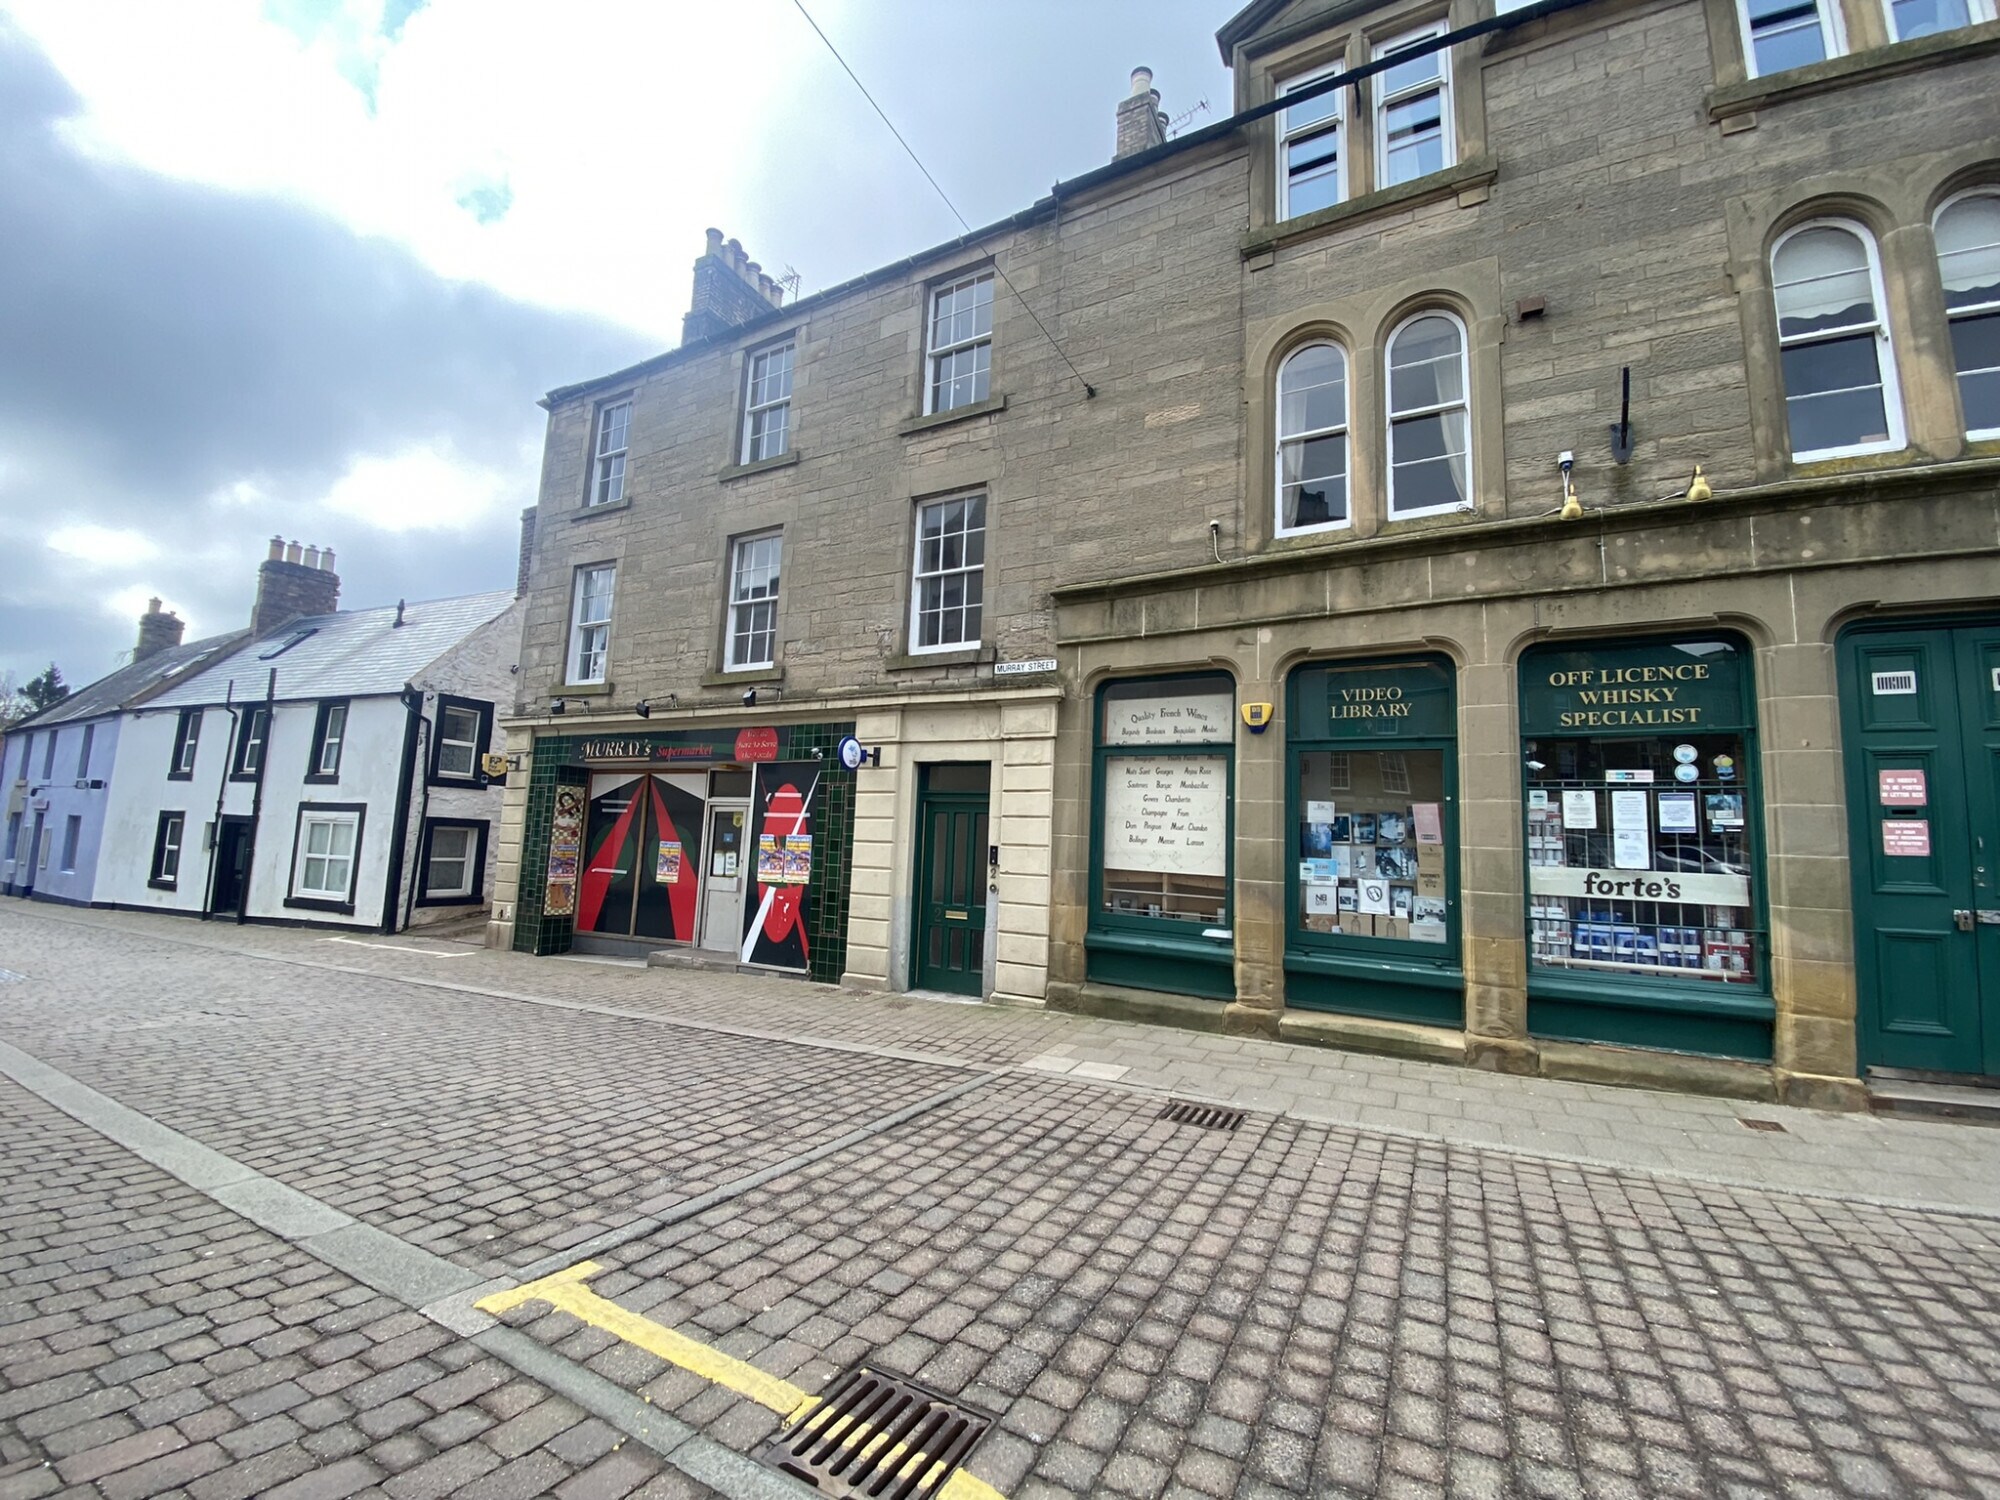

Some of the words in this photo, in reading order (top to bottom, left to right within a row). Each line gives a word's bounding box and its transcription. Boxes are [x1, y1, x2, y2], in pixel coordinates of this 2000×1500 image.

[996, 664, 1025, 673] MURRAY
[1028, 661, 1054, 671] STREET
[1549, 670, 1594, 687] OFF
[1600, 664, 1709, 684] LICENCE
[1341, 686, 1402, 702] VIDEO
[1579, 687, 1678, 705] WHISKY
[1131, 710, 1155, 723] Quality
[1160, 708, 1181, 718] French
[1186, 708, 1208, 720] Wines
[1331, 703, 1412, 719] LIBRARY
[1560, 707, 1701, 727] SPECIALIST
[656, 744, 712, 760] Supermarket
[1142, 808, 1167, 817] Champagne
[1177, 808, 1189, 817] From
[1125, 821, 1137, 829] Dom
[990, 868, 996, 878] 2
[1584, 872, 1680, 899] forte's
[934, 908, 942, 922] 2
